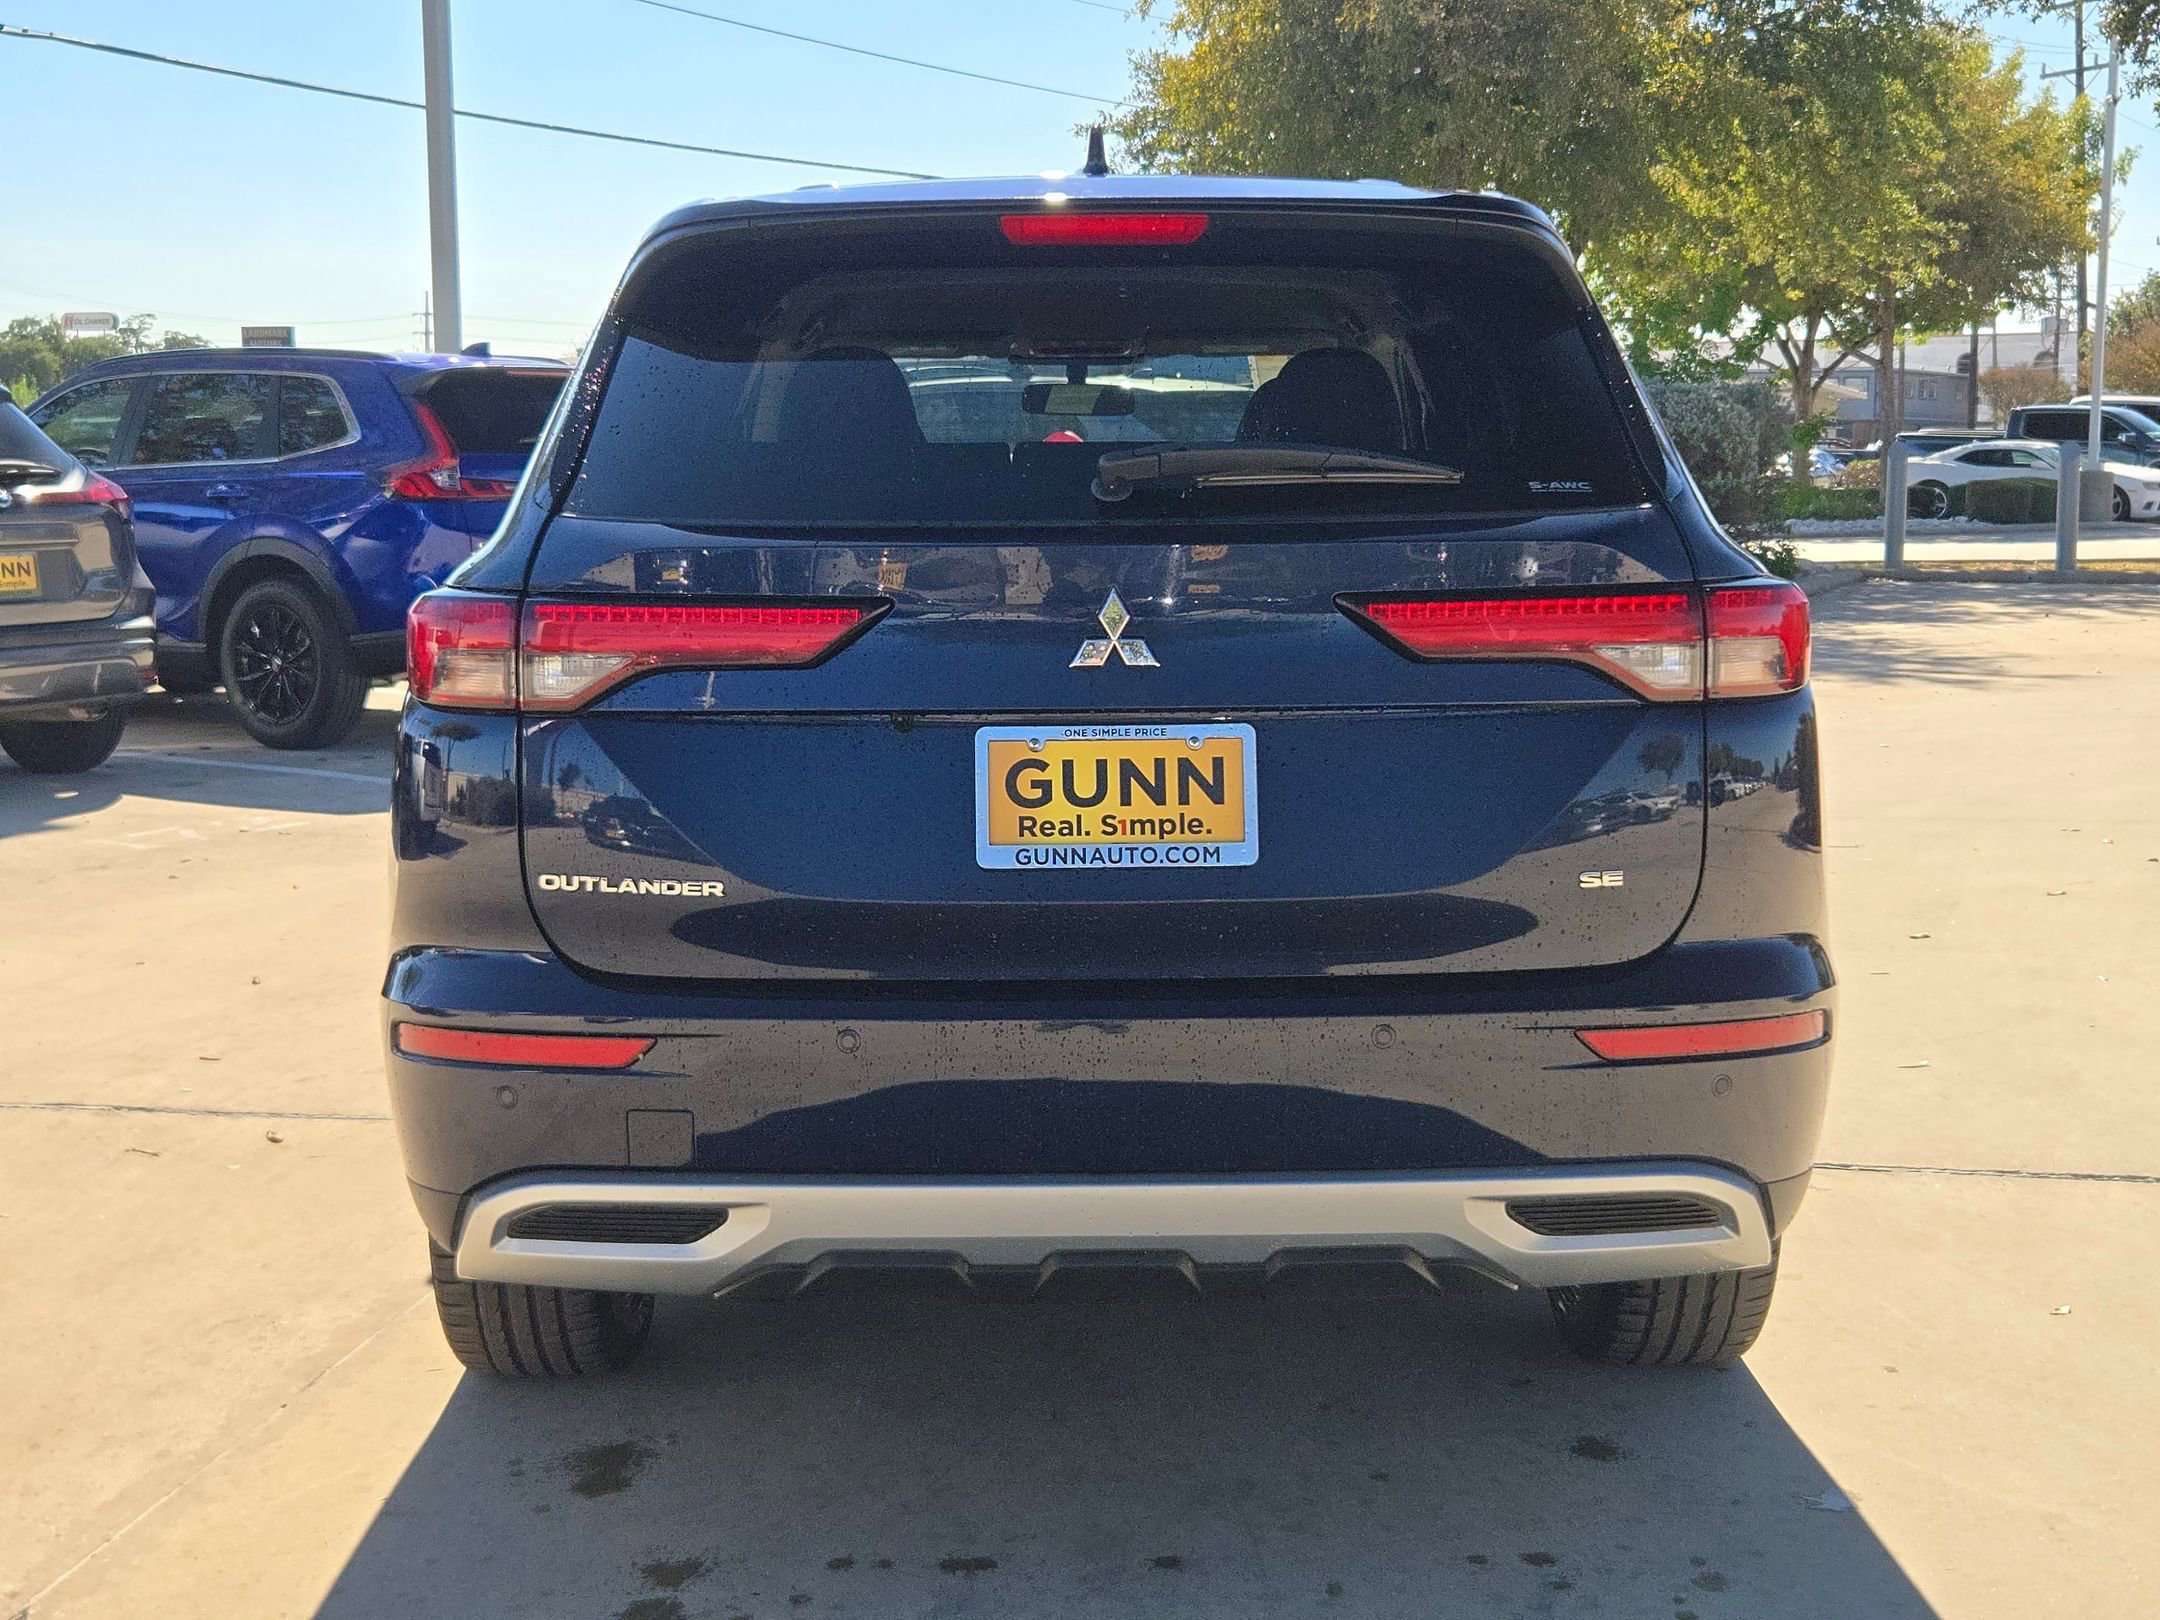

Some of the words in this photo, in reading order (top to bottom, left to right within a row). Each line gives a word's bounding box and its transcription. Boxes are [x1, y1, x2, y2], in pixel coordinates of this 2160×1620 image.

[1529, 481, 1591, 489] S-AWC
[1064, 728, 1088, 737] ONE
[1092, 728, 1131, 737] SIMPLE
[1134, 727, 1167, 737] PRICE
[1004, 756, 1225, 809] GUNN
[1018, 815, 1091, 838] Real.
[1015, 846, 1221, 866] GUNNAUTO.COM
[538, 873, 725, 897] OUTLANDER
[1579, 870, 1624, 888] SE
